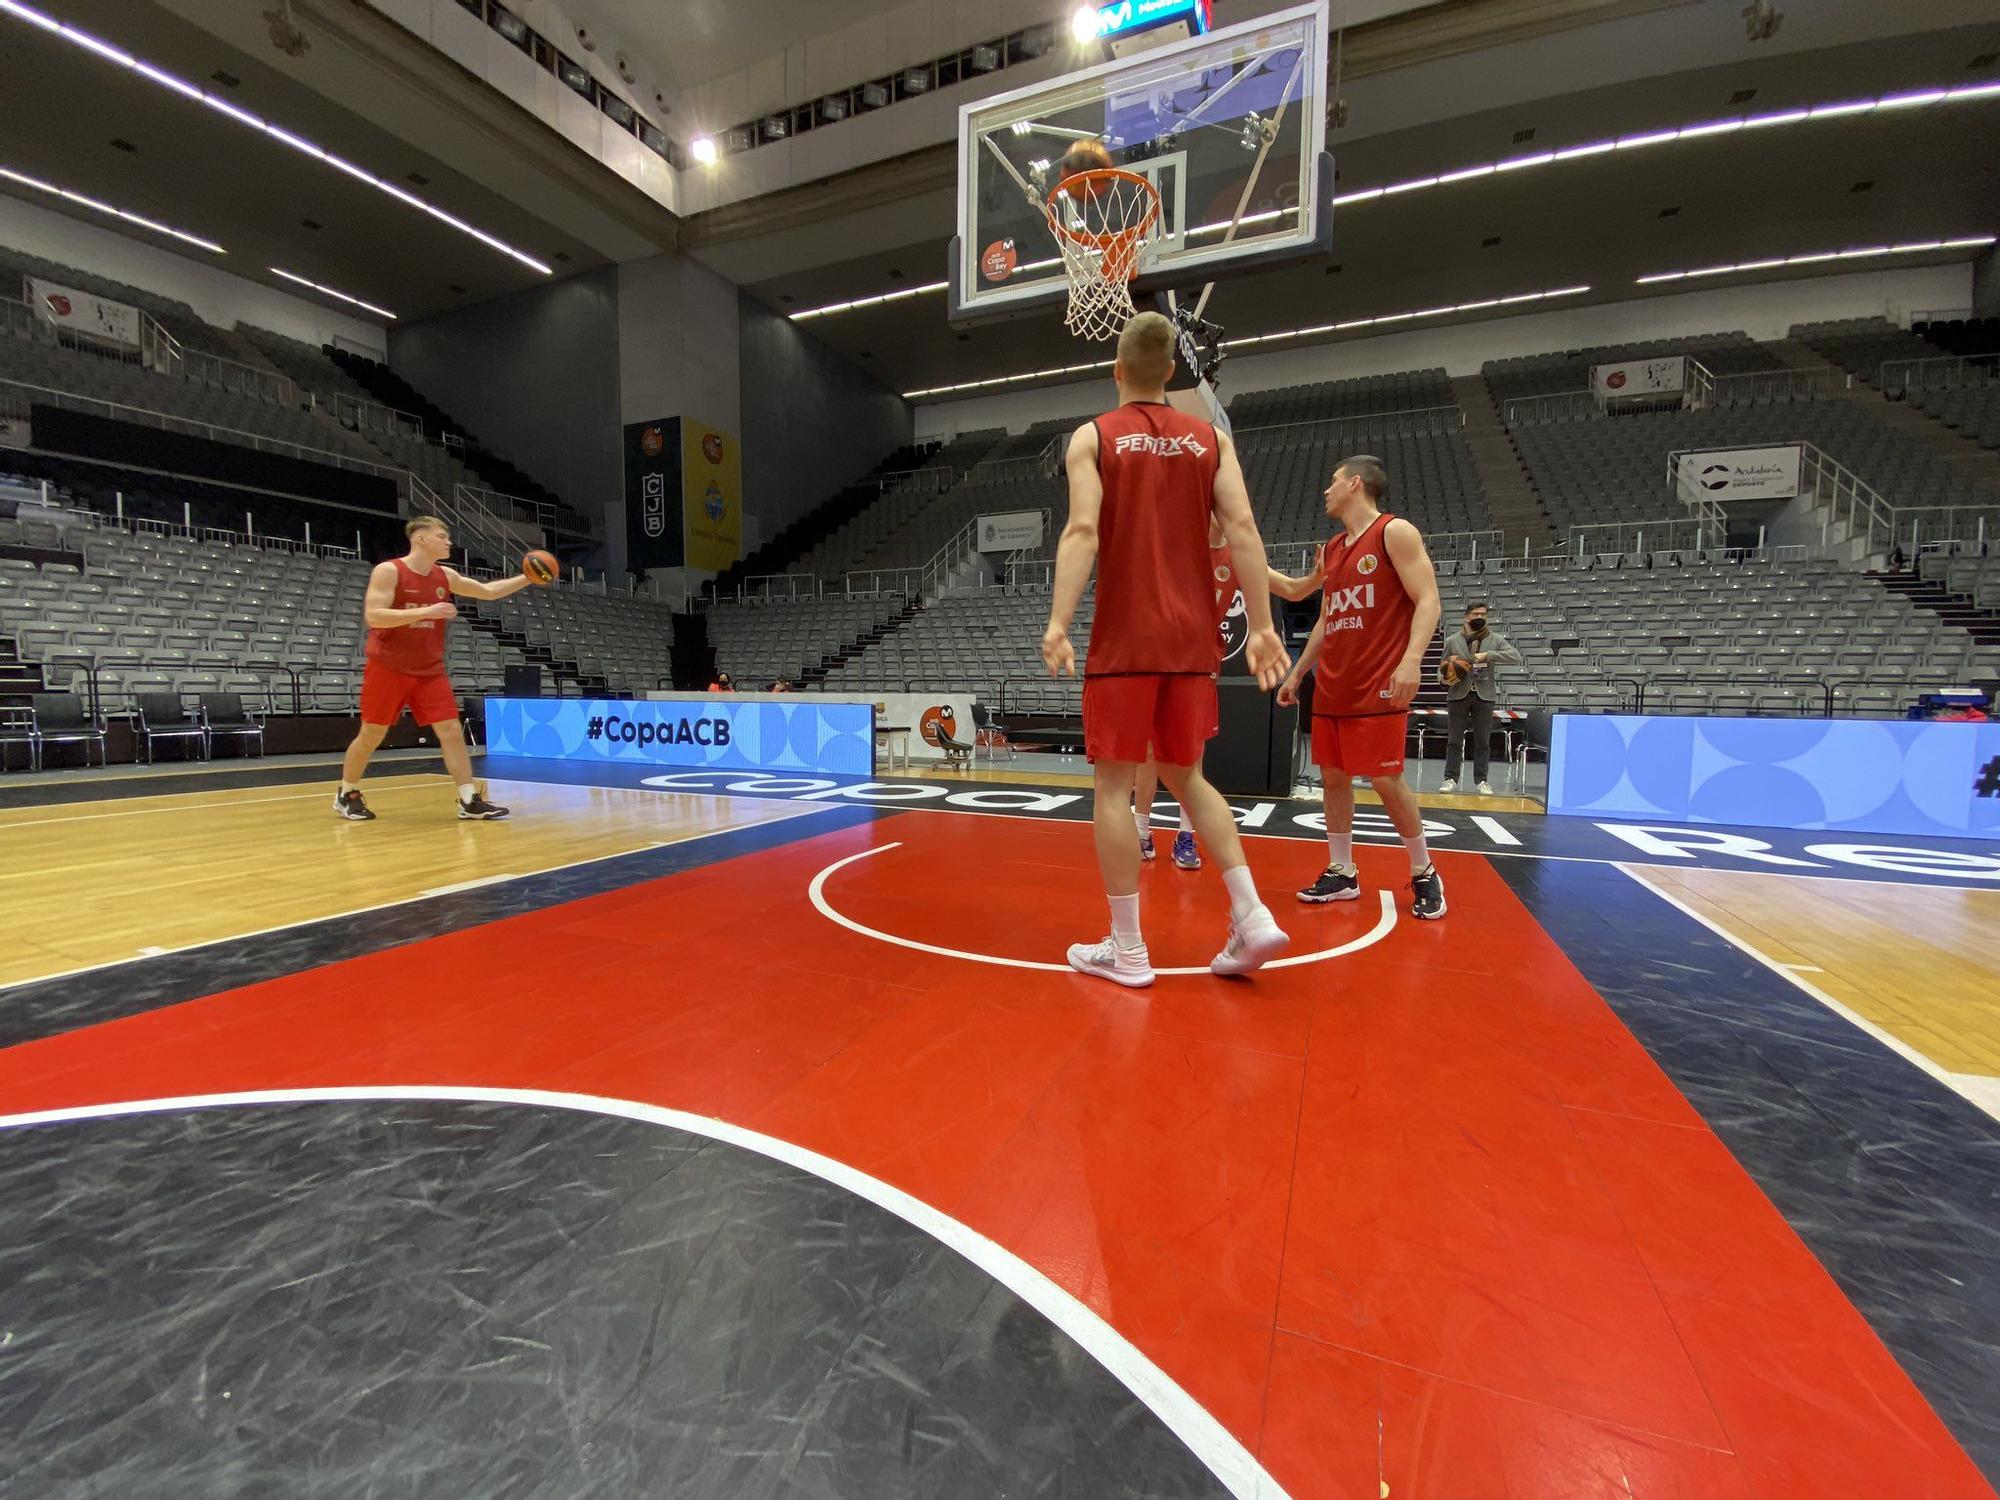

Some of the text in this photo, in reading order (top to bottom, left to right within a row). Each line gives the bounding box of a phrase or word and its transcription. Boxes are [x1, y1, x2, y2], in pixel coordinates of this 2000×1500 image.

[1326, 583, 1375, 616] AXI
[587, 715, 730, 748] #CopaACB
[640, 772, 2000, 880] Copa del Re
